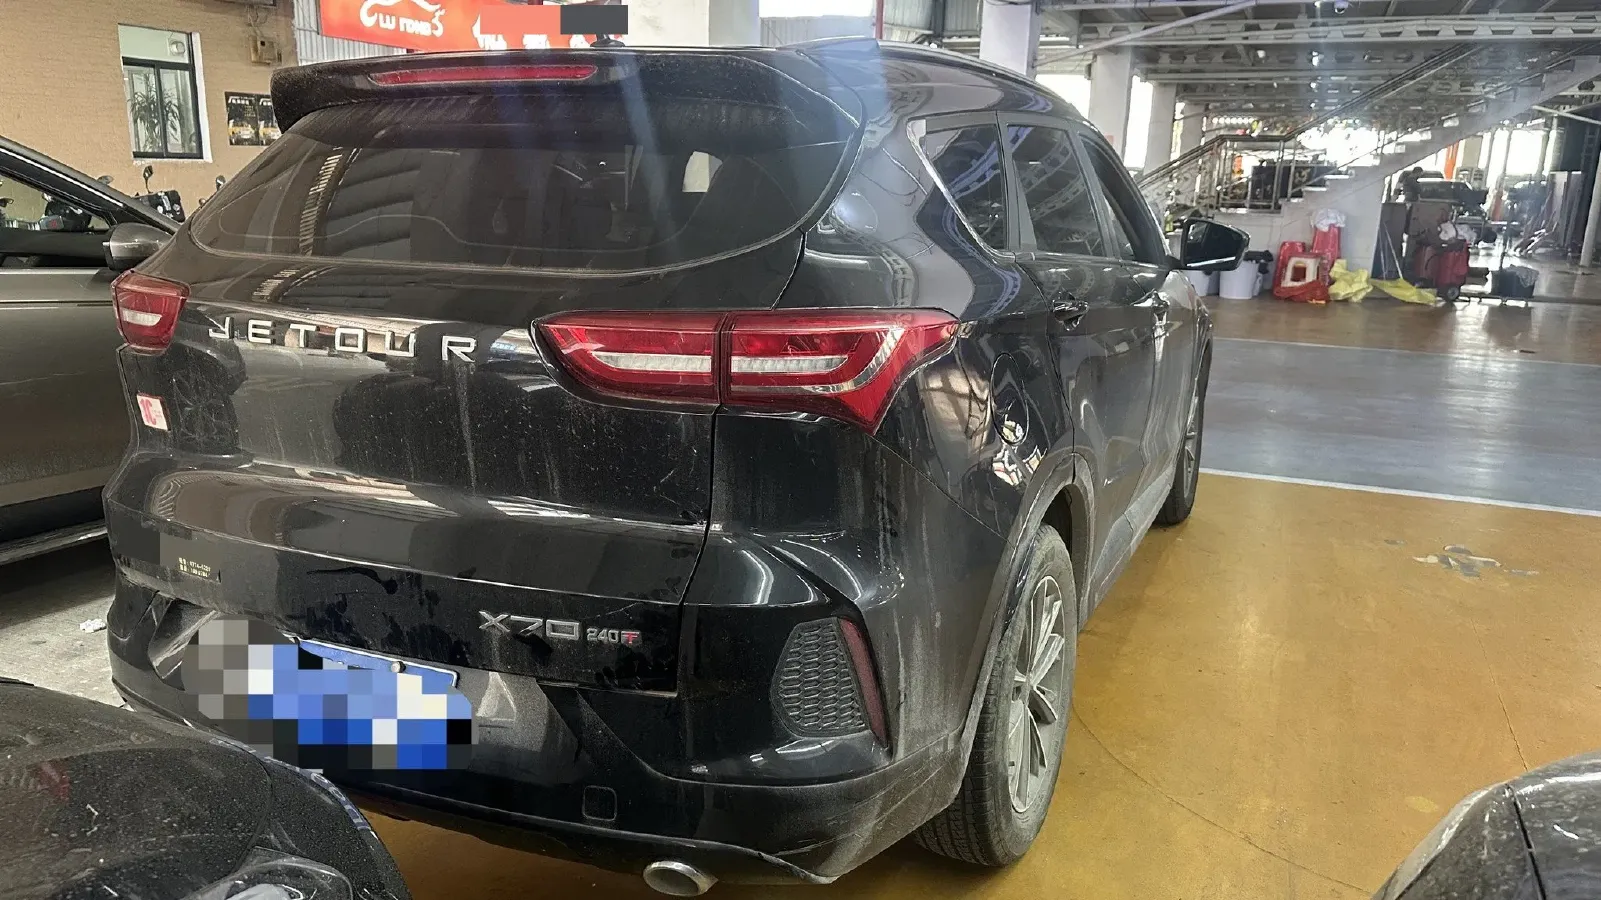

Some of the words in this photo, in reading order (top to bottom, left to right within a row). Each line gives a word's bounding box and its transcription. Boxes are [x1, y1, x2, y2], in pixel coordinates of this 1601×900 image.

[208, 316, 477, 363] JETOUR
[478, 609, 580, 641] X70
[586, 627, 641, 646] 240T
